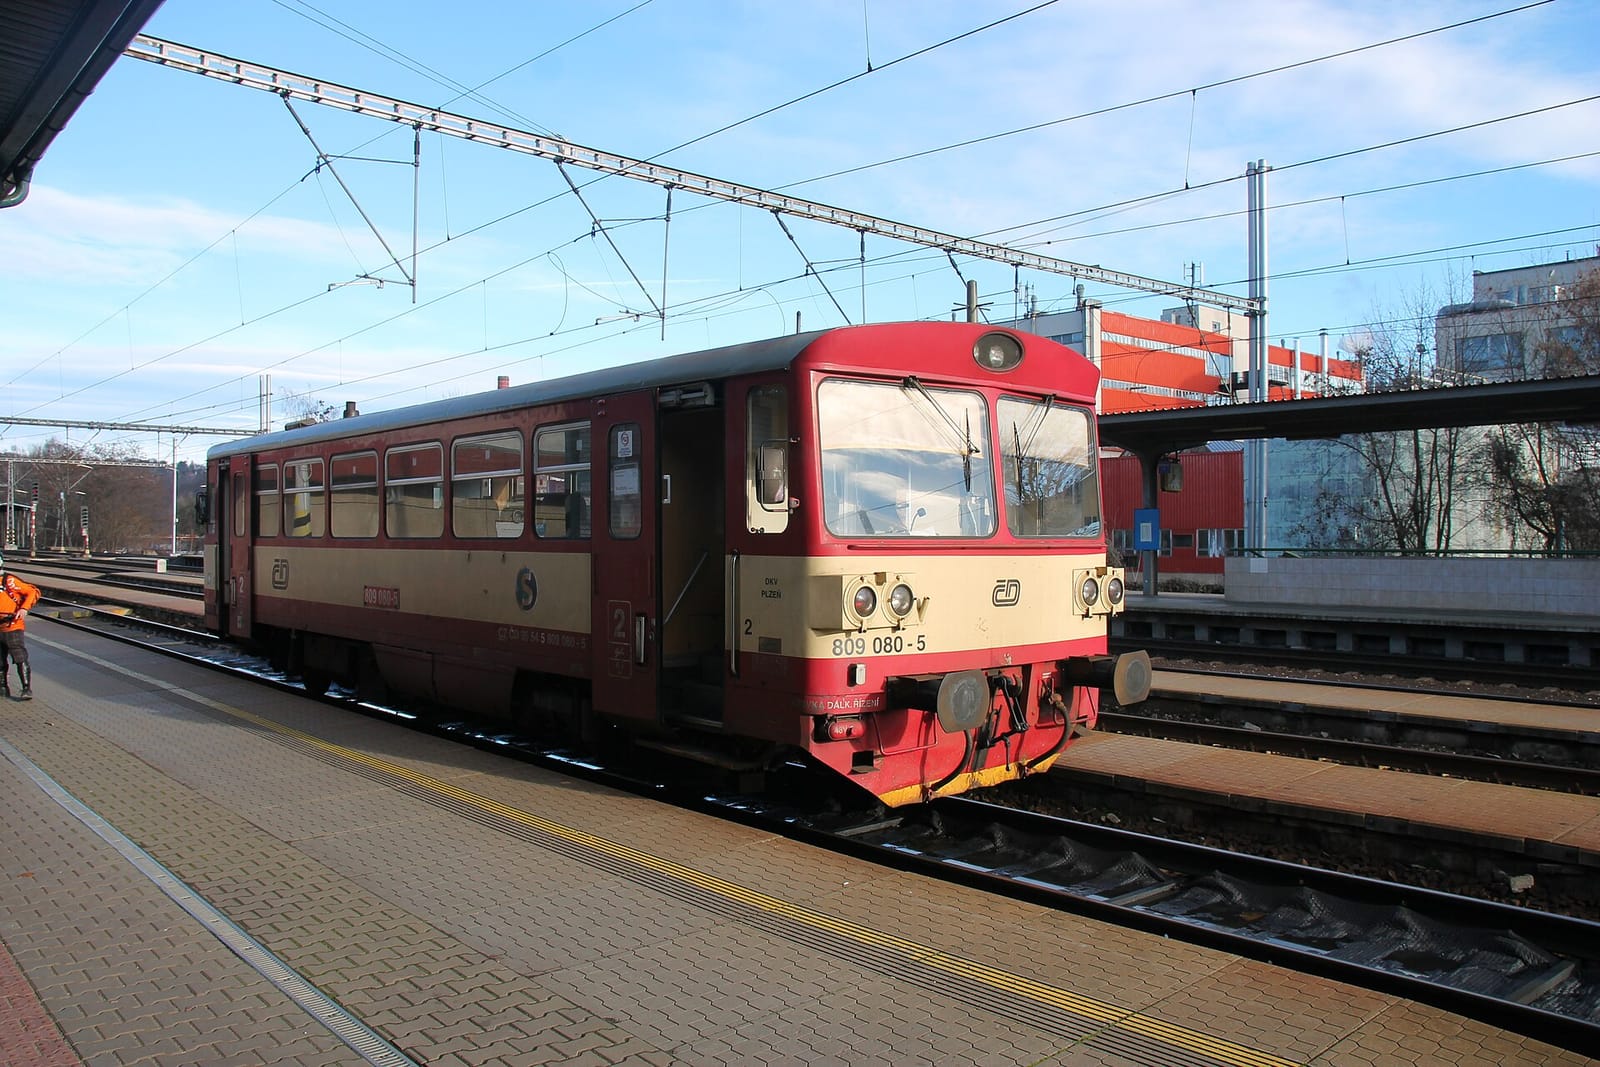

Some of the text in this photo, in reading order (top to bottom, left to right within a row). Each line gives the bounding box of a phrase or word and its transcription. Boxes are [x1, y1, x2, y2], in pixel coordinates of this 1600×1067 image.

[764, 577, 778, 586] DKV
[613, 608, 626, 638] 2
[744, 618, 753, 636] 2
[832, 638, 866, 656] 809
